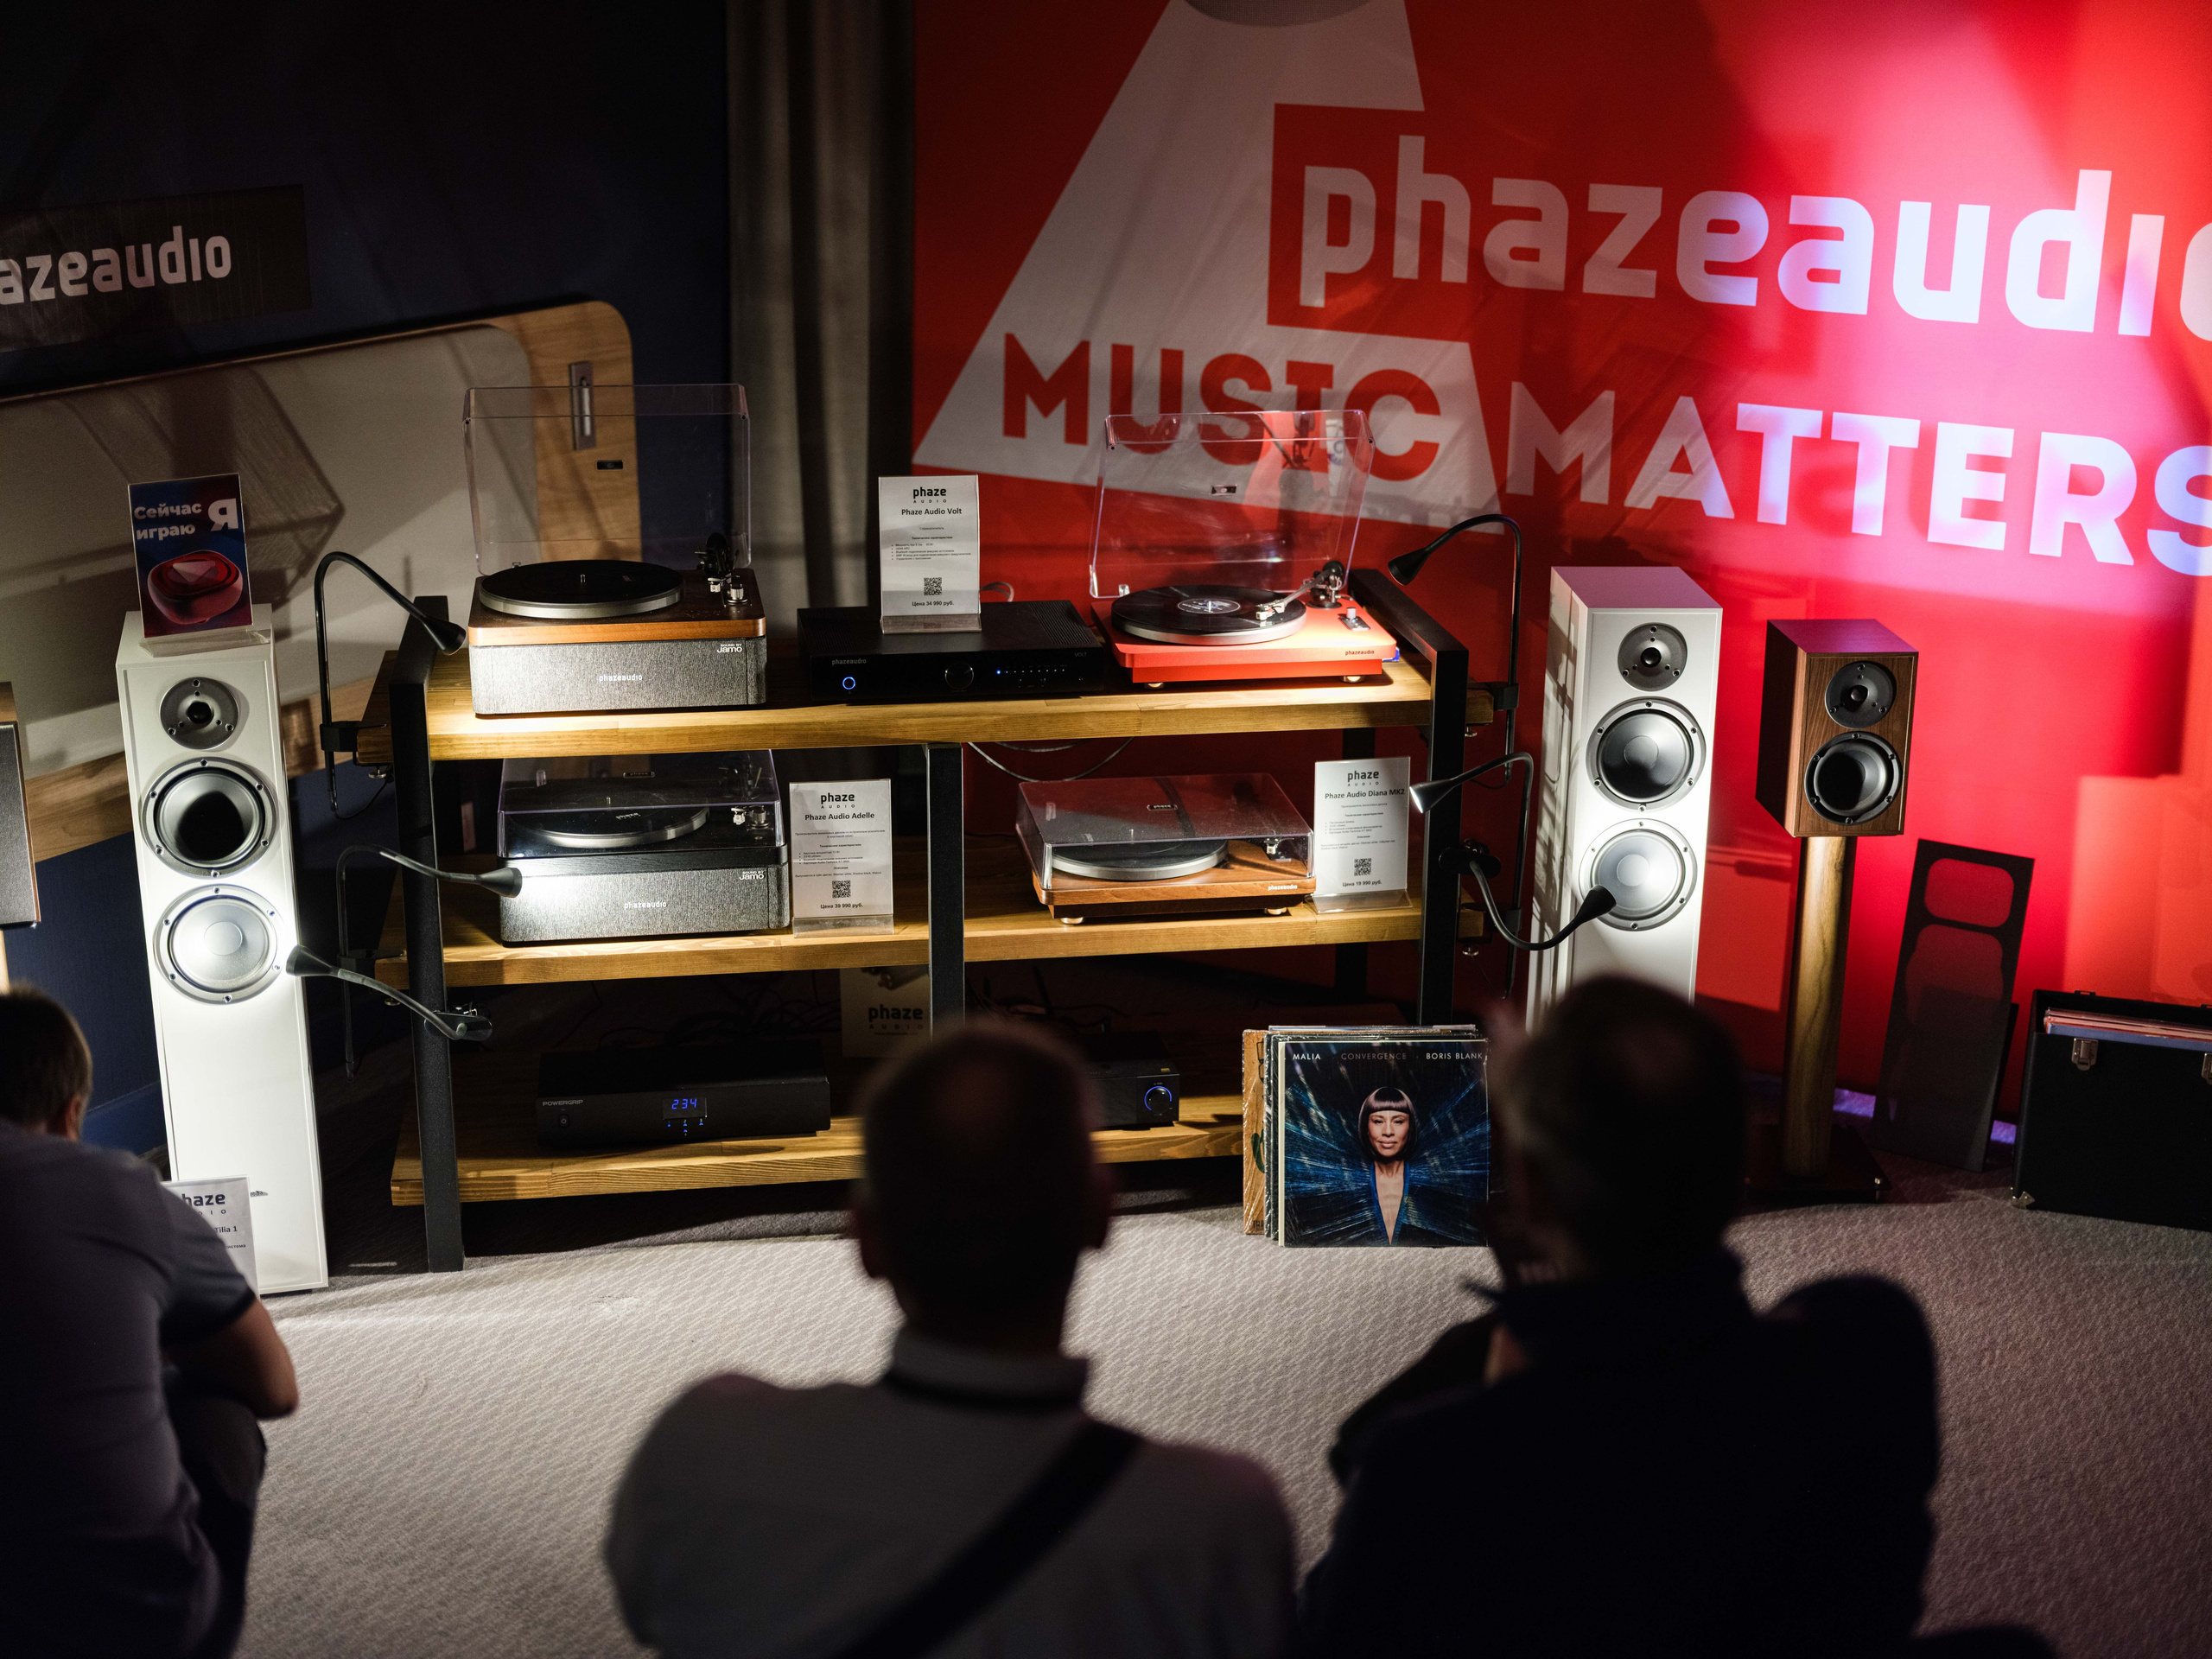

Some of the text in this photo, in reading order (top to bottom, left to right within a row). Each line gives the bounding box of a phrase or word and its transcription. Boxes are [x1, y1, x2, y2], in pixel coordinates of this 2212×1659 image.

[1001, 333, 2212, 577] MUSIC MATTERS
[912, 486, 947, 499] phaze
[134, 502, 202, 519] Сейчас
[207, 498, 239, 531] Я
[136, 523, 196, 541] играю
[831, 658, 867, 666] phazeaudio
[599, 674, 643, 683] phazeaudio
[1347, 770, 1379, 782] phaze
[820, 792, 855, 804] phaze
[624, 900, 667, 910] phazeaudio
[868, 1004, 923, 1023] phaze
[671, 1098, 697, 1109] 234
[181, 1193, 226, 1207] haze
